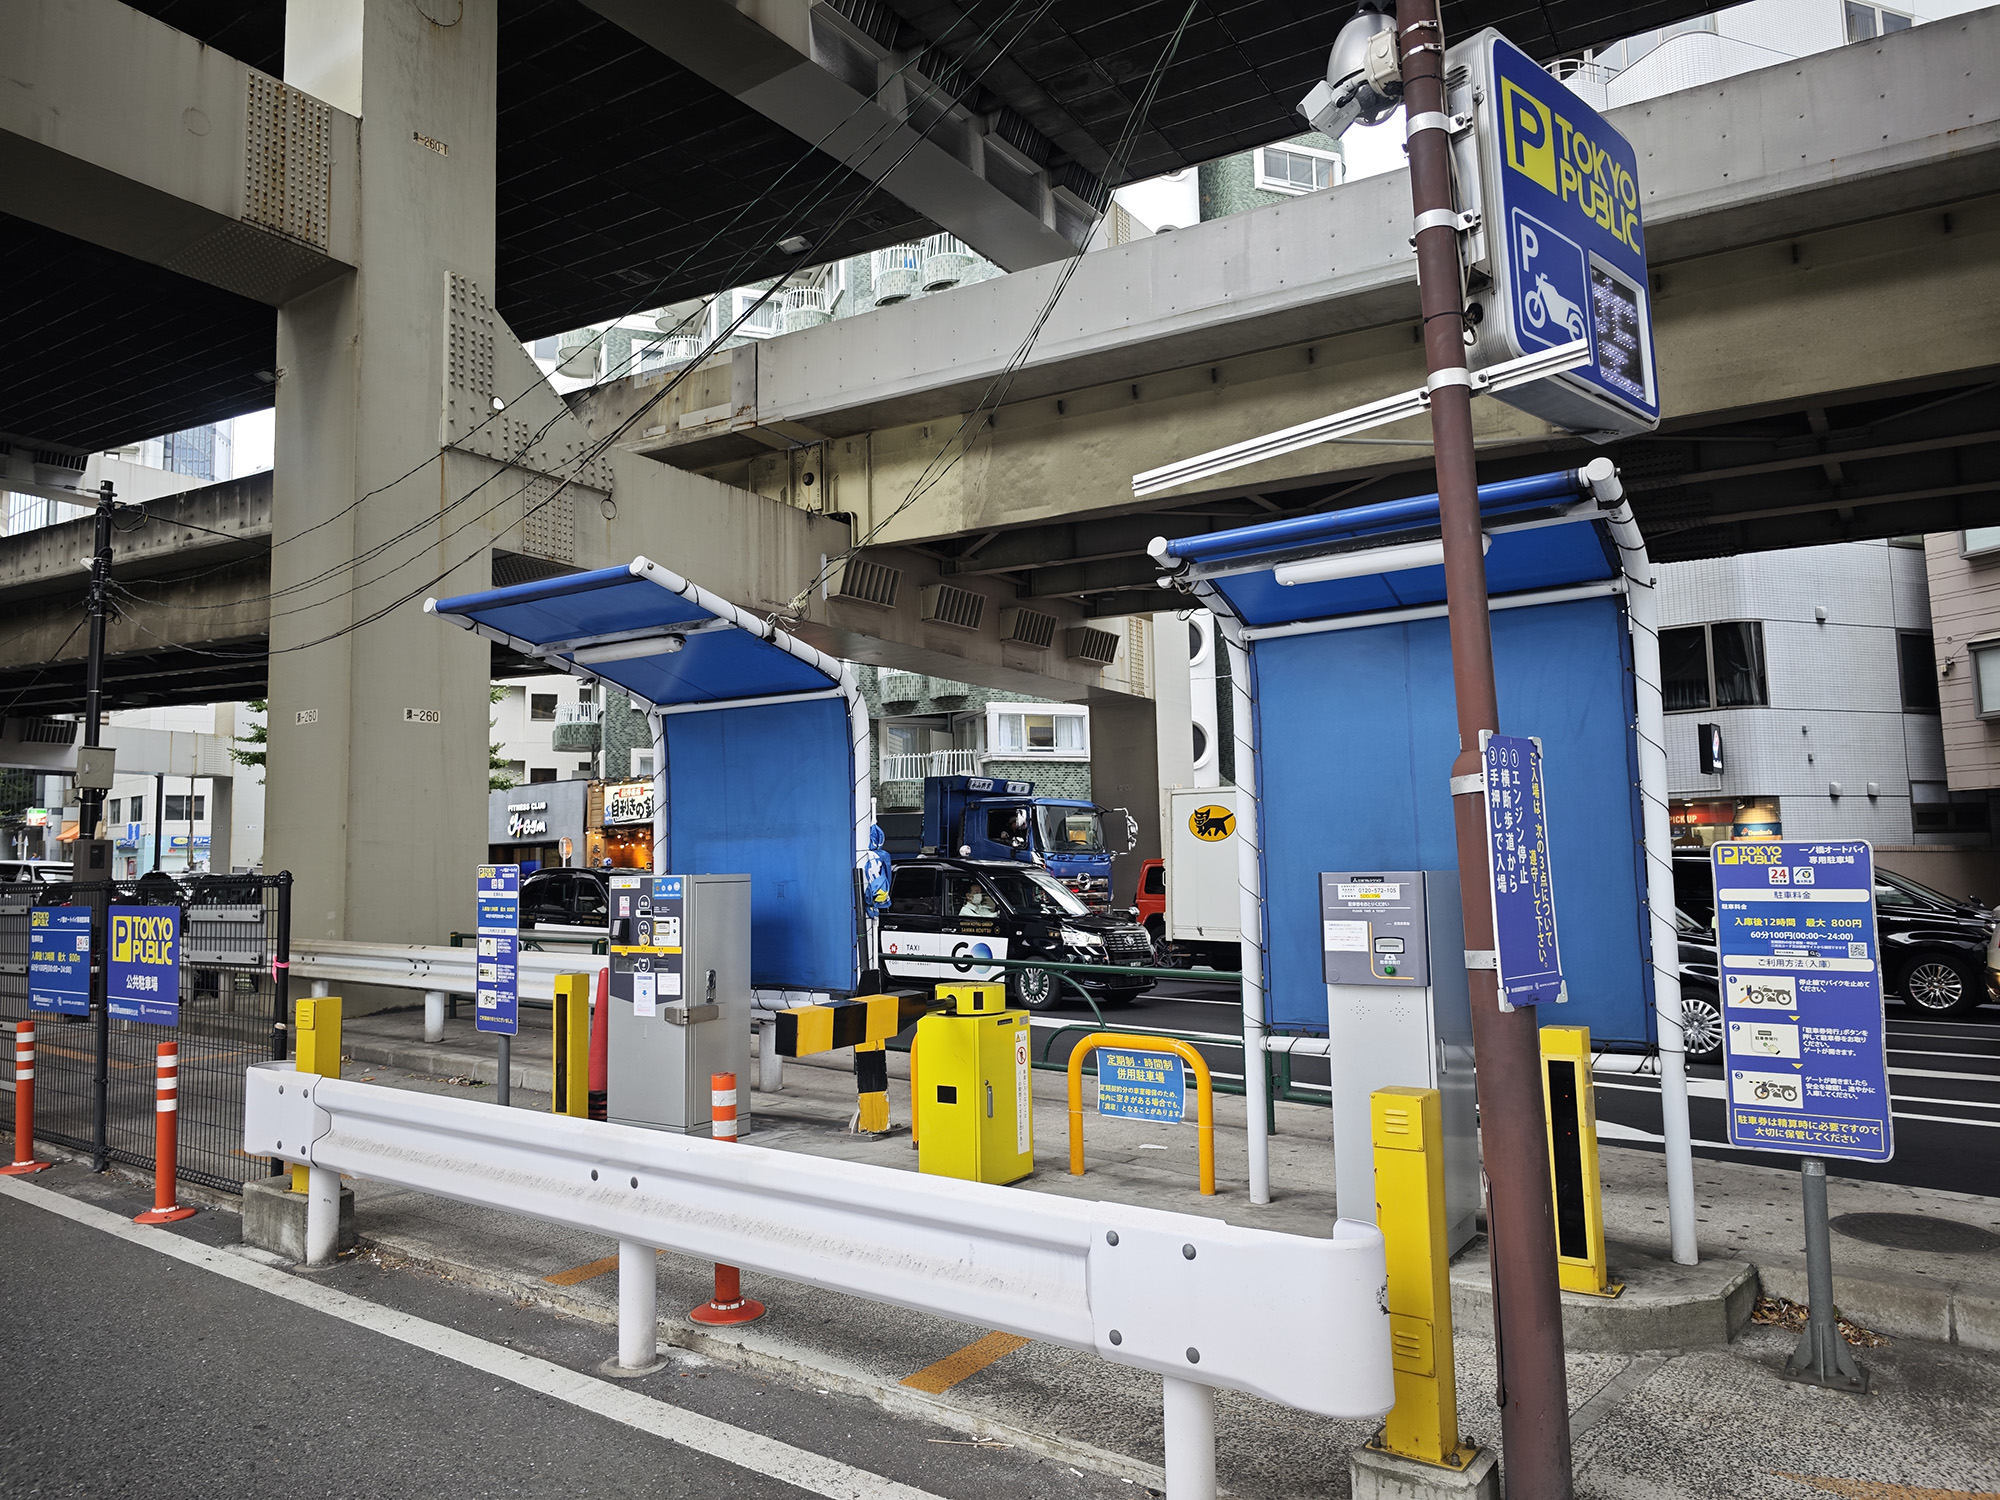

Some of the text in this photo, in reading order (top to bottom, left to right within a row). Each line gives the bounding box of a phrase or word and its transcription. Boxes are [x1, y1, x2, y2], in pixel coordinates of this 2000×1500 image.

[1554, 112, 1637, 211] TOKYO
[1559, 158, 1641, 257] PUBLIC
[1520, 223, 1539, 273] P
[508, 802, 546, 812] FITNESS CLUB
[1686, 815, 1698, 823] UP
[1739, 846, 1782, 856] TOKYO
[1799, 845, 1866, 854] 一ノ橋オートバイ
[1740, 855, 1782, 865] PUBLIC
[1809, 856, 1854, 864] 専用駐車場
[1771, 869, 1787, 879] 24
[1774, 891, 1811, 899] 駐車料金
[1734, 917, 1862, 928] 入庫後12時間 最大 800円
[132, 916, 173, 941] TOKYO
[132, 939, 173, 966] PUBLIC
[126, 974, 159, 992] 公共駐車場
[1803, 1047, 1857, 1056] ゲートが開きます。
[1106, 1054, 1174, 1071] 定期制・時間制
[1117, 1067, 1165, 1083] 併用駐車場
[1805, 1076, 1868, 1087] ゲートが開きましたら
[1738, 1115, 1880, 1136] 駐車券は精算時に必要ですので
[1754, 1126, 1861, 1144] 大切に保管してください
